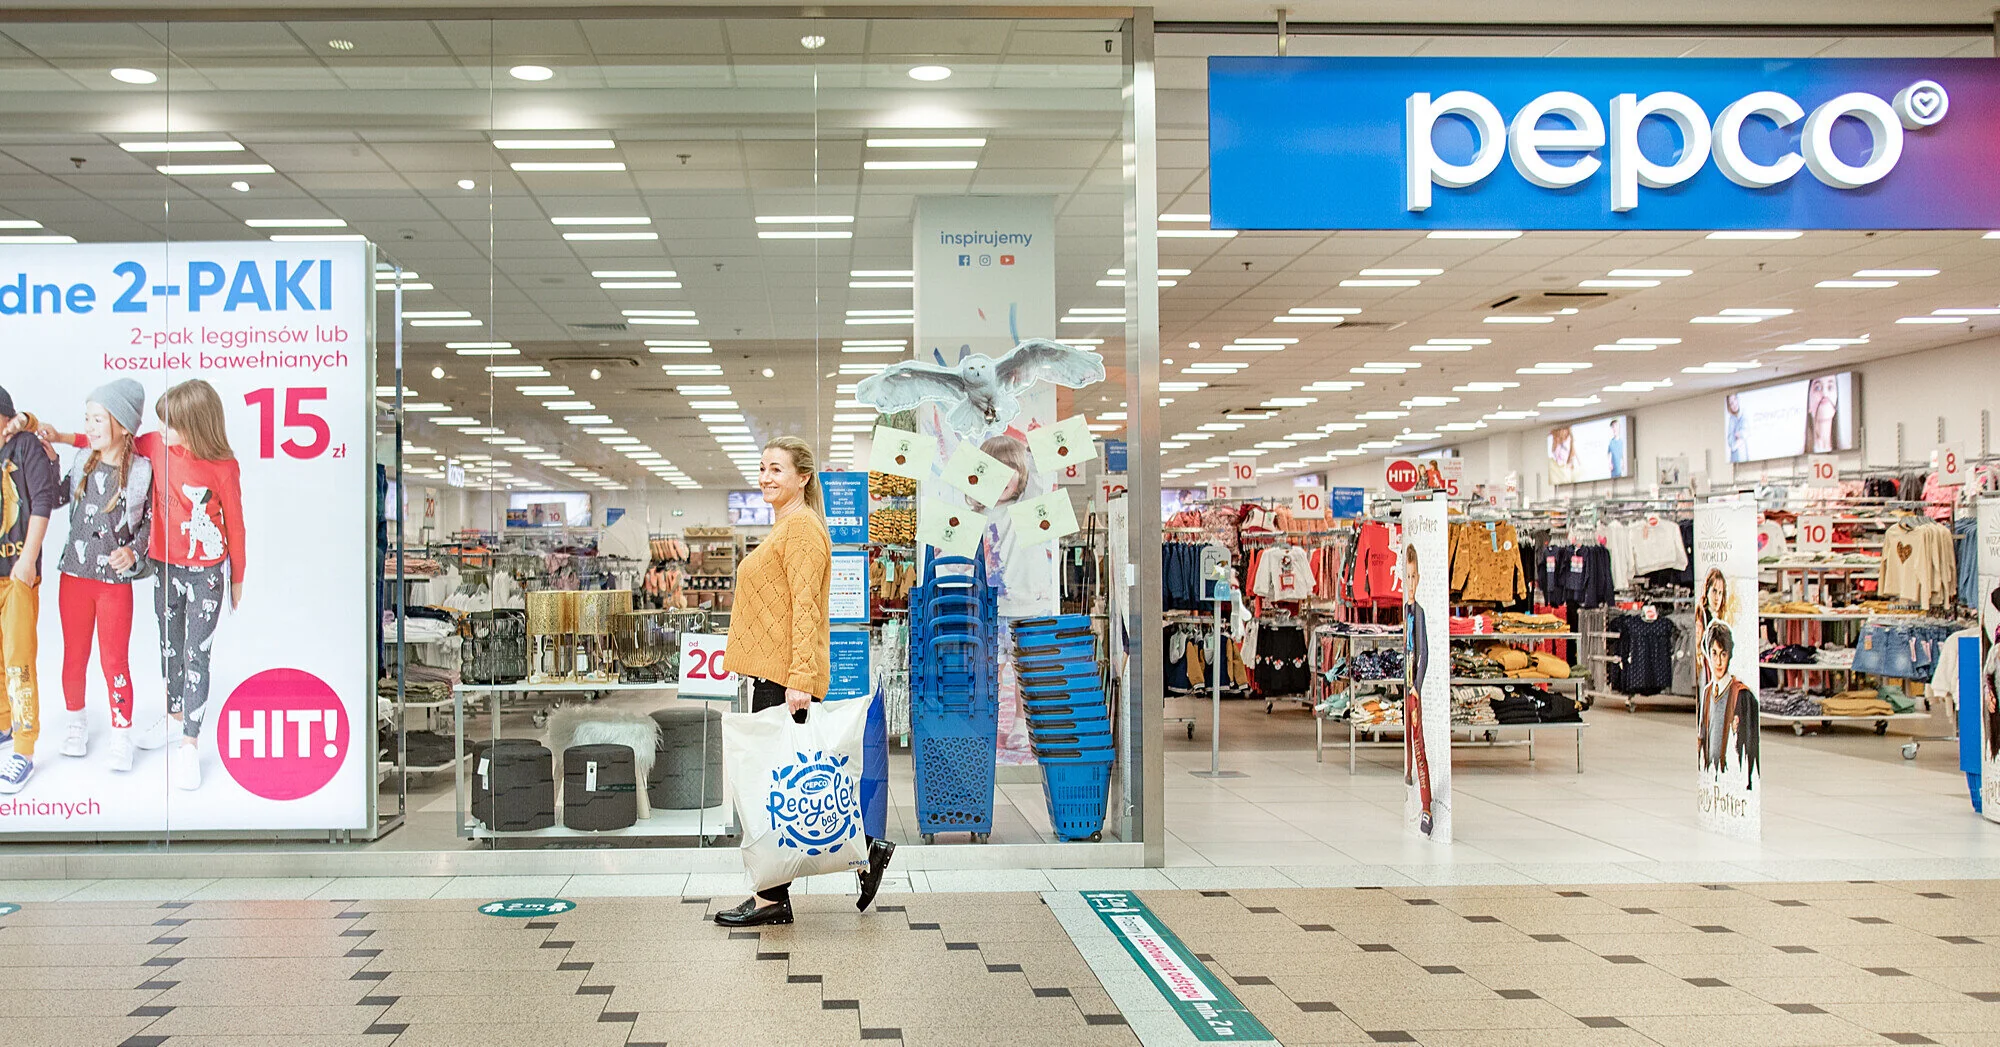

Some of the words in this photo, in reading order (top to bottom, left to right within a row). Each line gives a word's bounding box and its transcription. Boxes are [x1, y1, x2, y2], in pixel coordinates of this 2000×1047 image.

[1405, 91, 1904, 212] pepco
[940, 230, 1033, 248] inspirujemy
[112, 259, 332, 313] 2-PAKI
[130, 326, 194, 349] 2-pak
[201, 325, 308, 348] legginsów
[316, 324, 348, 343] lub
[104, 351, 191, 370] koszulek
[200, 349, 348, 371] bawełnianych
[244, 387, 331, 460] 15
[332, 444, 347, 459] zł
[1233, 465, 1251, 480] 10
[1813, 463, 1833, 479] 10
[1946, 452, 1956, 474] 8
[1388, 469, 1415, 483] HIT!
[1212, 486, 1227, 499] 15
[1299, 494, 1319, 510] 10
[1804, 525, 1826, 543] 10
[687, 648, 730, 680] 20
[228, 709, 338, 759] HIT!
[804, 779, 828, 790] PEPCO
[0, 798, 100, 820] ełnianych
[1713, 785, 1748, 818] Potter
[821, 812, 840, 834] bag
